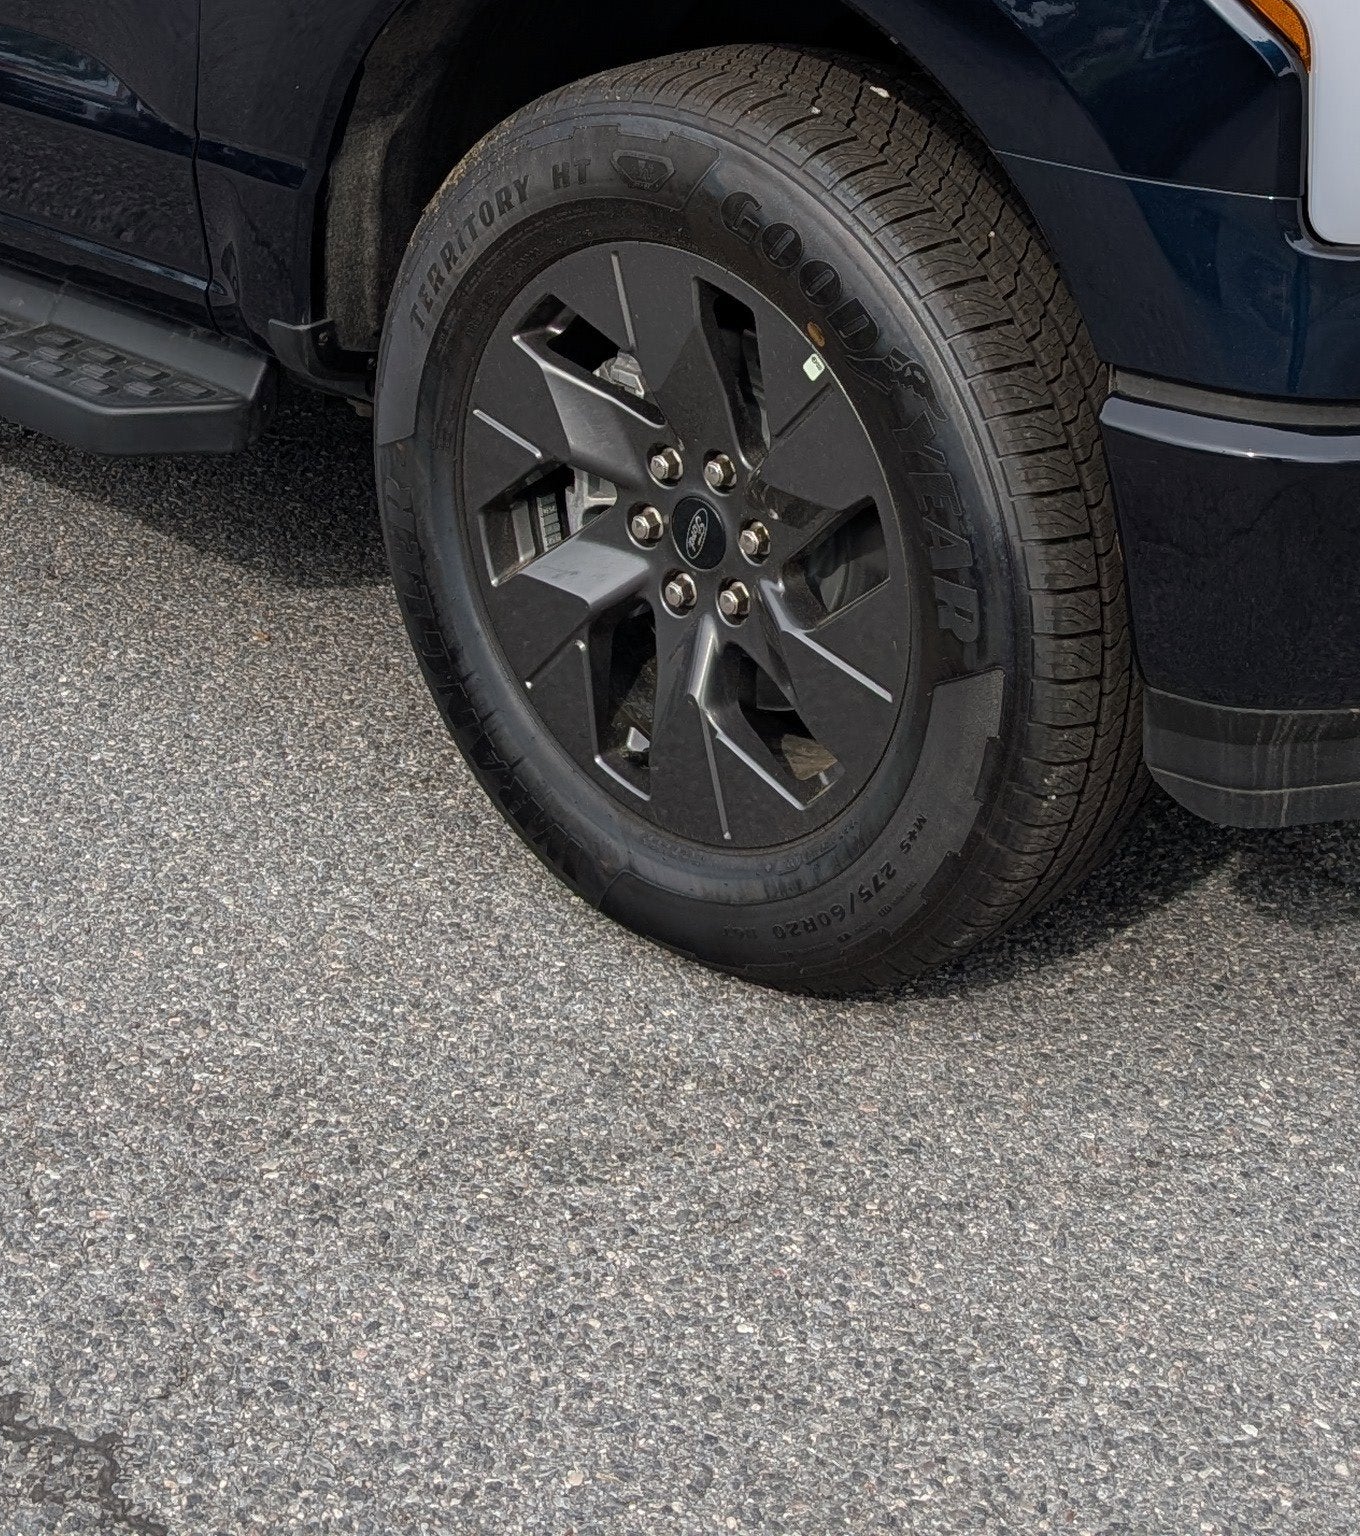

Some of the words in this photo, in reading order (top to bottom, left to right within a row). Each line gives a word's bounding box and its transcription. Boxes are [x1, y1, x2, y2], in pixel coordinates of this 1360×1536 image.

[408, 174, 531, 332] TERRITORY
[550, 155, 593, 191] HT
[688, 515, 705, 553] Ford
[898, 812, 929, 856] M+S
[770, 860, 899, 941] 275/60R20
